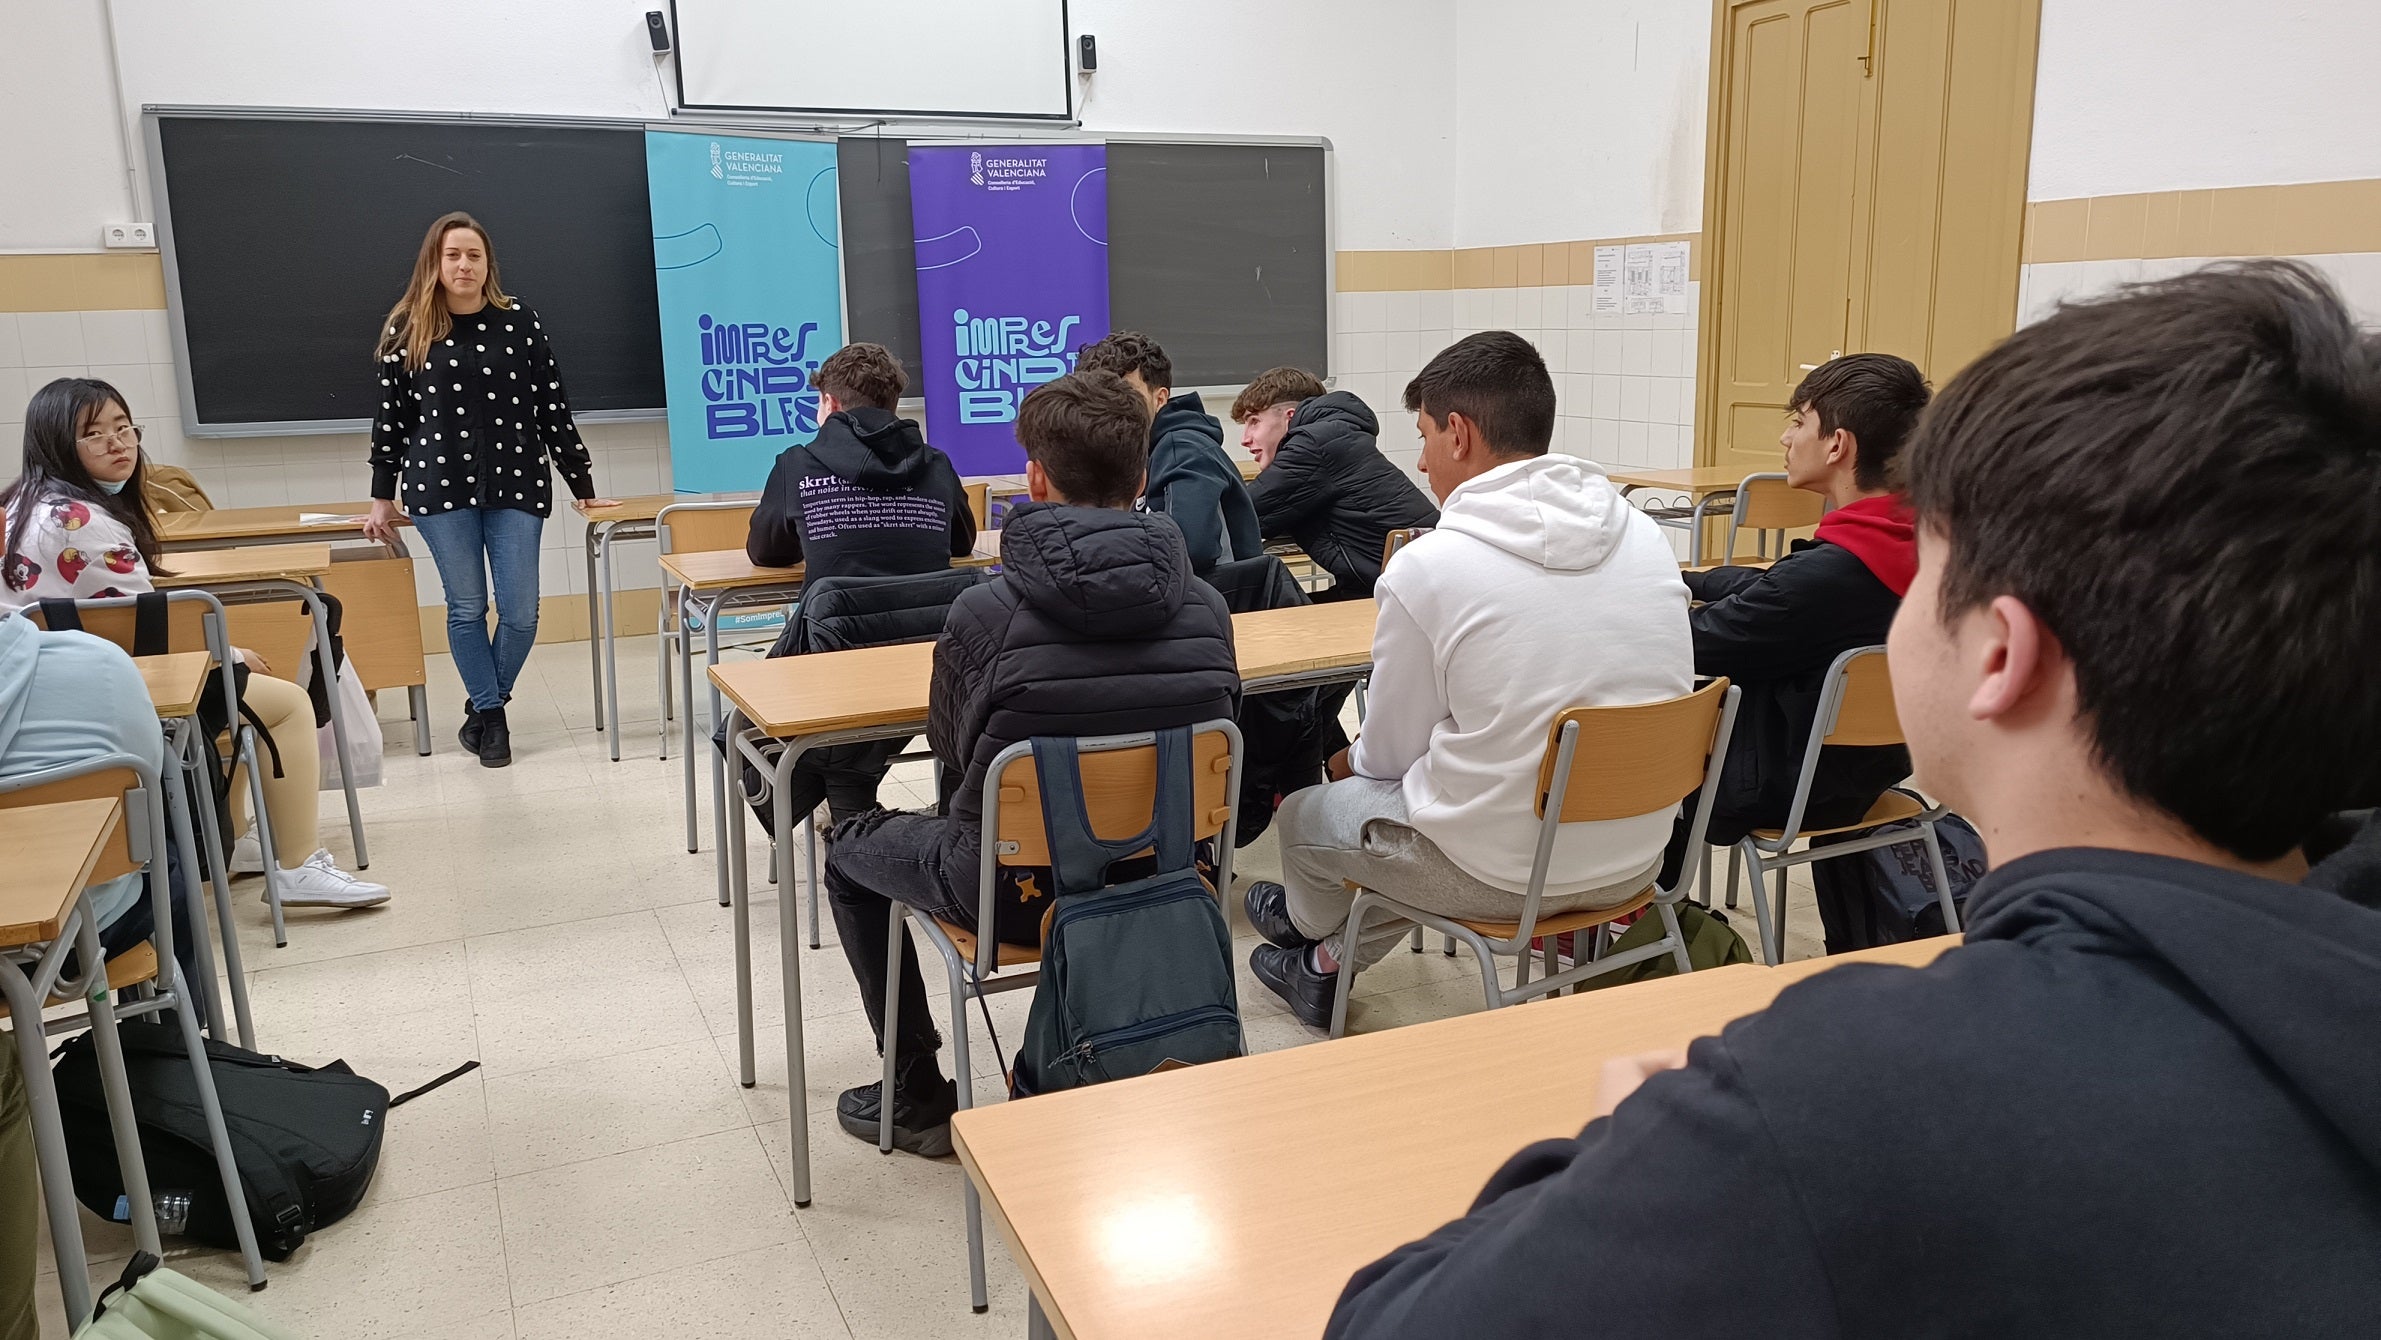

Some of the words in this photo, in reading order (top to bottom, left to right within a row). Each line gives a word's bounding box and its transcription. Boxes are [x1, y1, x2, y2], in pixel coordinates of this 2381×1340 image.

[724, 151, 783, 163] GENERALITAT
[726, 162, 783, 173] VALENCIANA
[986, 159, 1047, 168] GENERALITAT
[987, 168, 1047, 178] VALENCIANA
[799, 475, 837, 490] skrrt
[800, 489, 816, 498] that
[817, 485, 839, 494] noise
[841, 484, 850, 492] in
[802, 499, 830, 508] Important
[810, 511, 829, 520] rubber
[869, 508, 881, 516] you
[863, 514, 881, 523] slang
[817, 524, 837, 533] humor.
